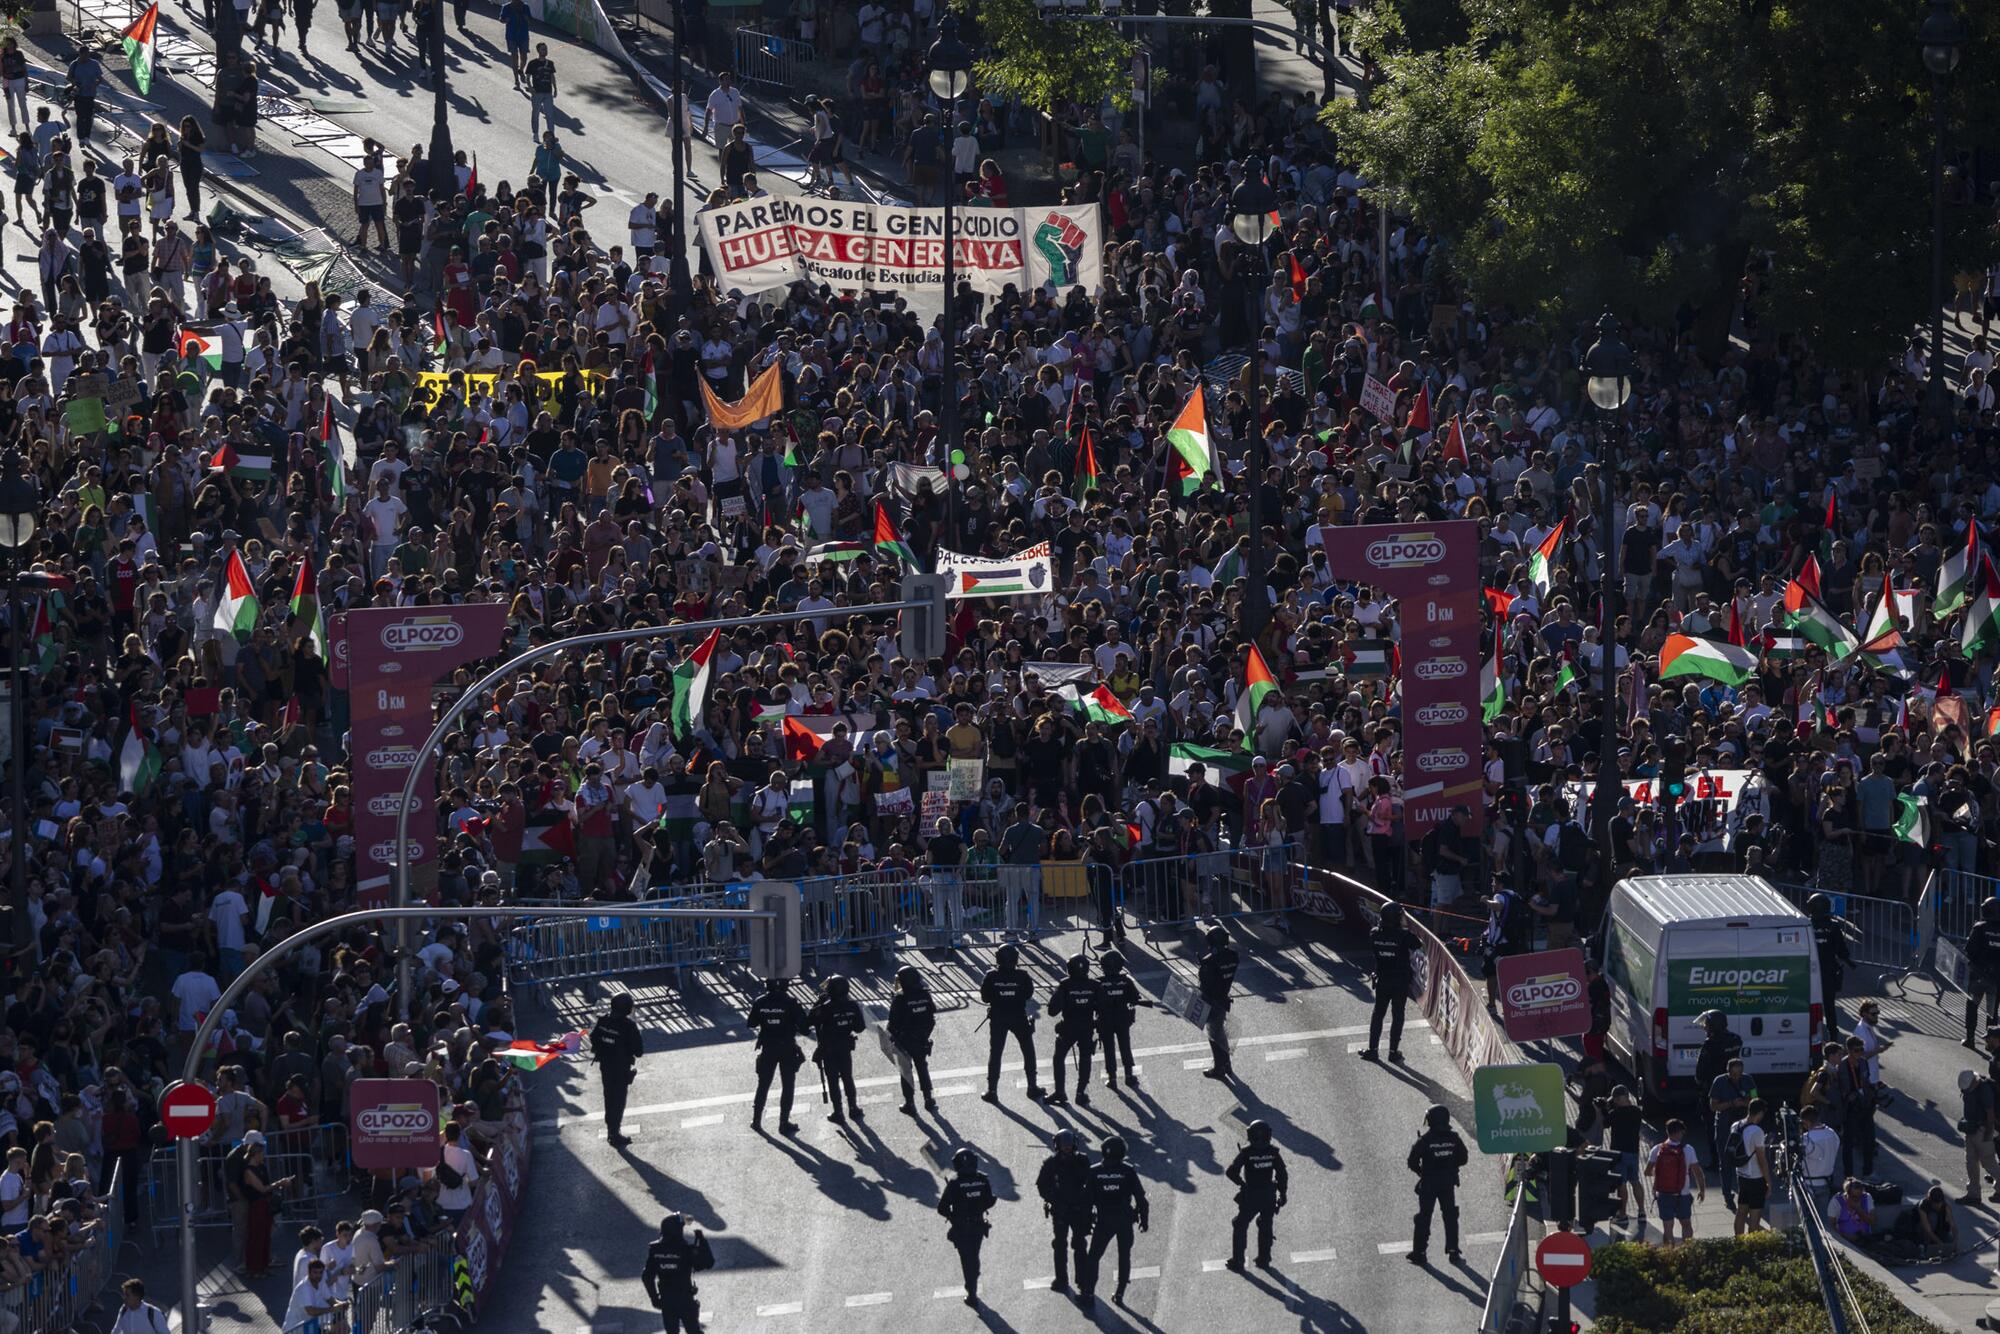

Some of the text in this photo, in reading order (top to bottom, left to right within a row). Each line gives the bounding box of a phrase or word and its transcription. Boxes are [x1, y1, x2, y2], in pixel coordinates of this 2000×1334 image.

[715, 201, 843, 237] PAREMOS
[852, 210, 877, 233] EL
[982, 242, 1020, 266] YA
[854, 266, 876, 282] de
[880, 268, 972, 284] Estudiates
[1427, 601, 1454, 622] 8 KM
[378, 690, 405, 711] 8 KM
[1415, 808, 1428, 822] LA
[1688, 966, 1789, 989] Europcar
[1688, 995, 1731, 1008] moving
[1763, 995, 1789, 1007] way
[1490, 1125, 1552, 1139] plenitude
